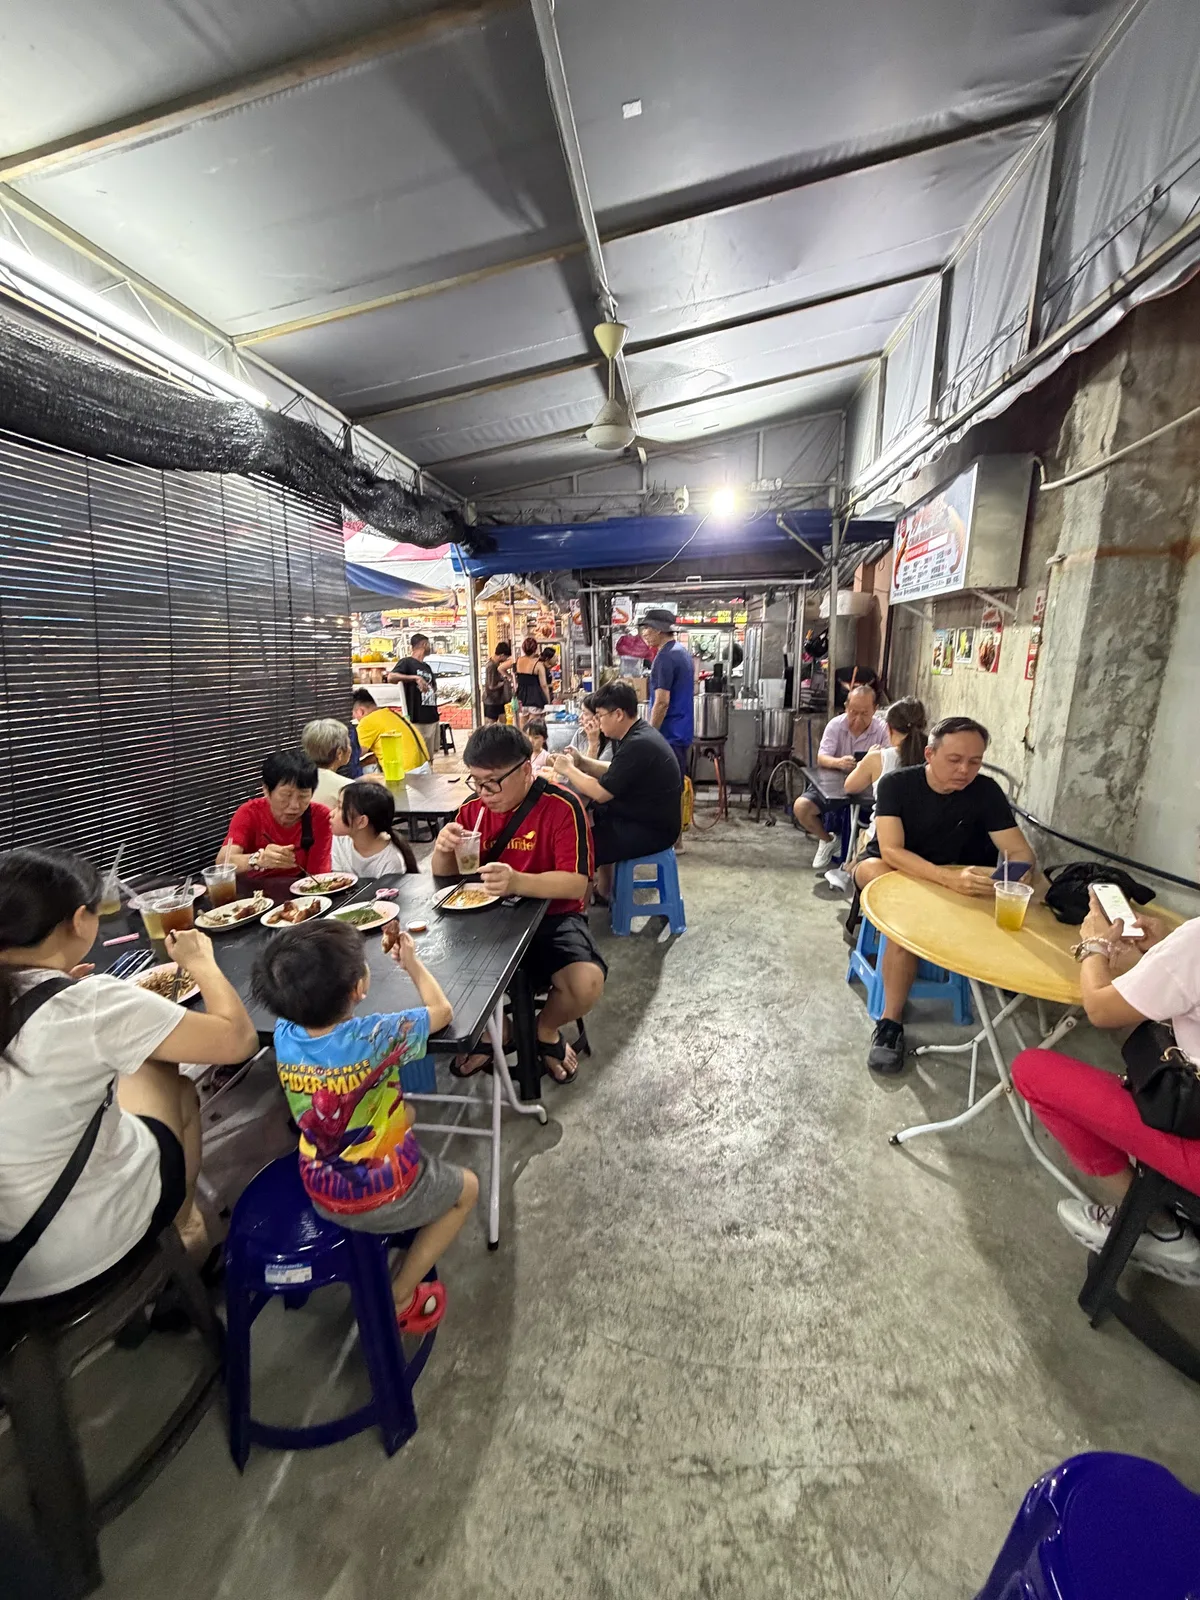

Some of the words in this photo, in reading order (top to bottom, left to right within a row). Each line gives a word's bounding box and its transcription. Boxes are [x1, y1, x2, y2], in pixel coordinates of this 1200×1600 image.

[278, 1063, 315, 1074] PIDER
[324, 1059, 369, 1076] SENSE
[279, 1069, 372, 1094] PIDER-MAN
